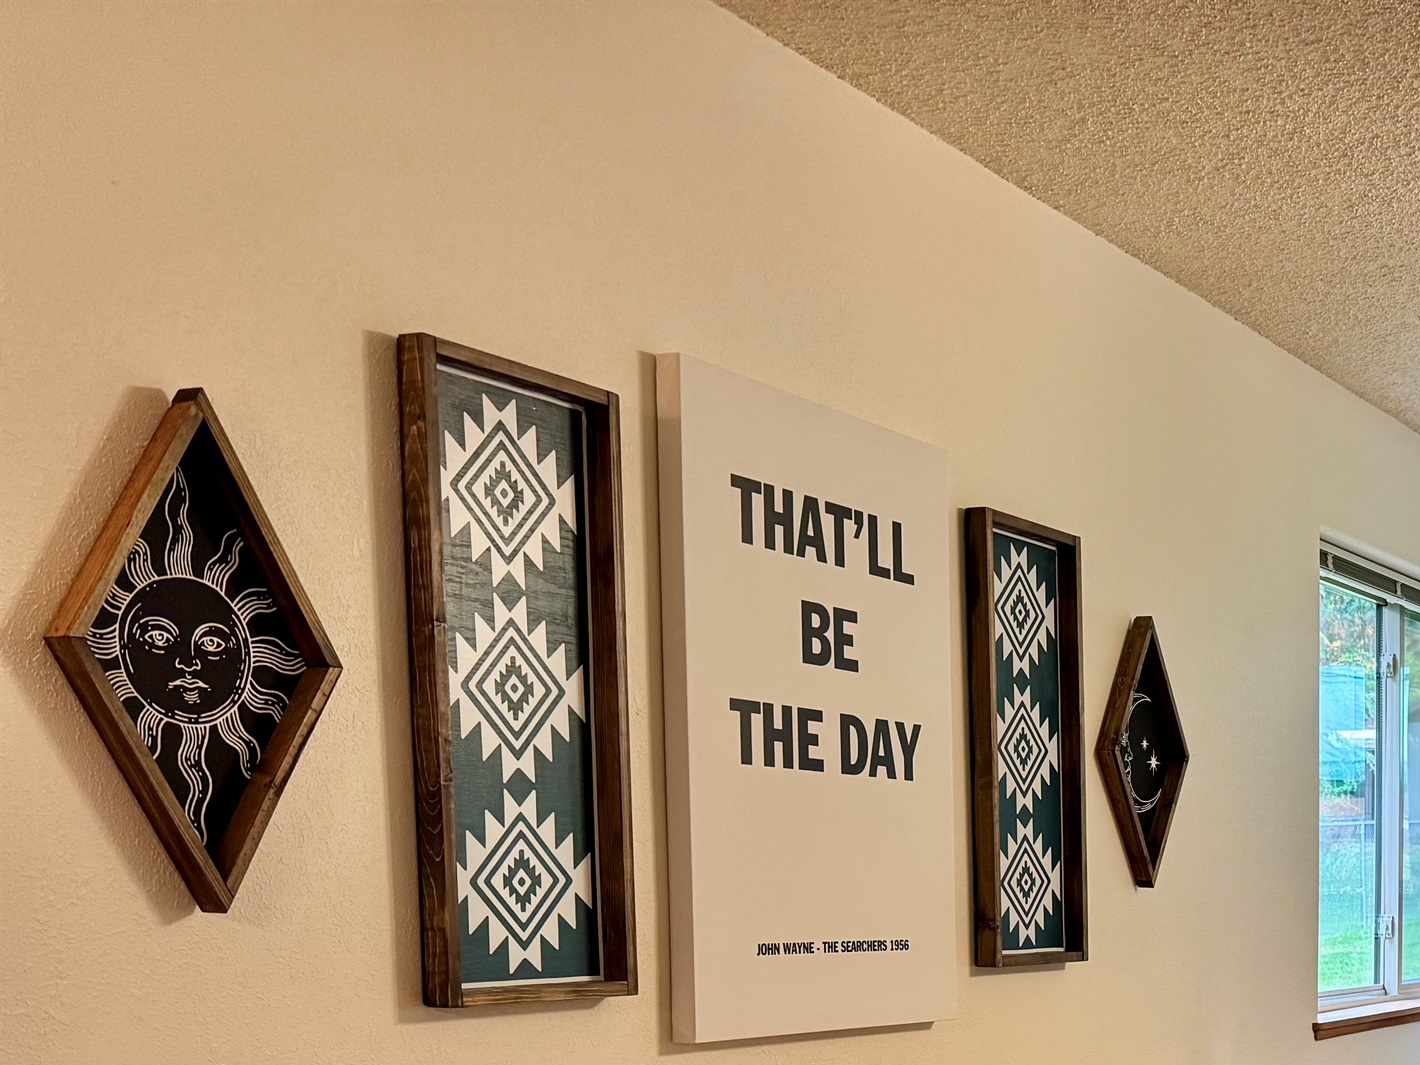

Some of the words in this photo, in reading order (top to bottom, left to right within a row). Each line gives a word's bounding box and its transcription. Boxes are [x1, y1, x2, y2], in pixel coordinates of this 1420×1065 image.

[730, 472, 915, 586] THAT'LL
[801, 599, 859, 673] BE
[729, 697, 824, 772] THE
[839, 713, 922, 782] DAY
[757, 943, 780, 956] JOHN
[782, 942, 815, 955] WAYNE
[822, 941, 839, 953] THE
[841, 940, 888, 953] SEARCHERS
[890, 939, 910, 951] 1956
